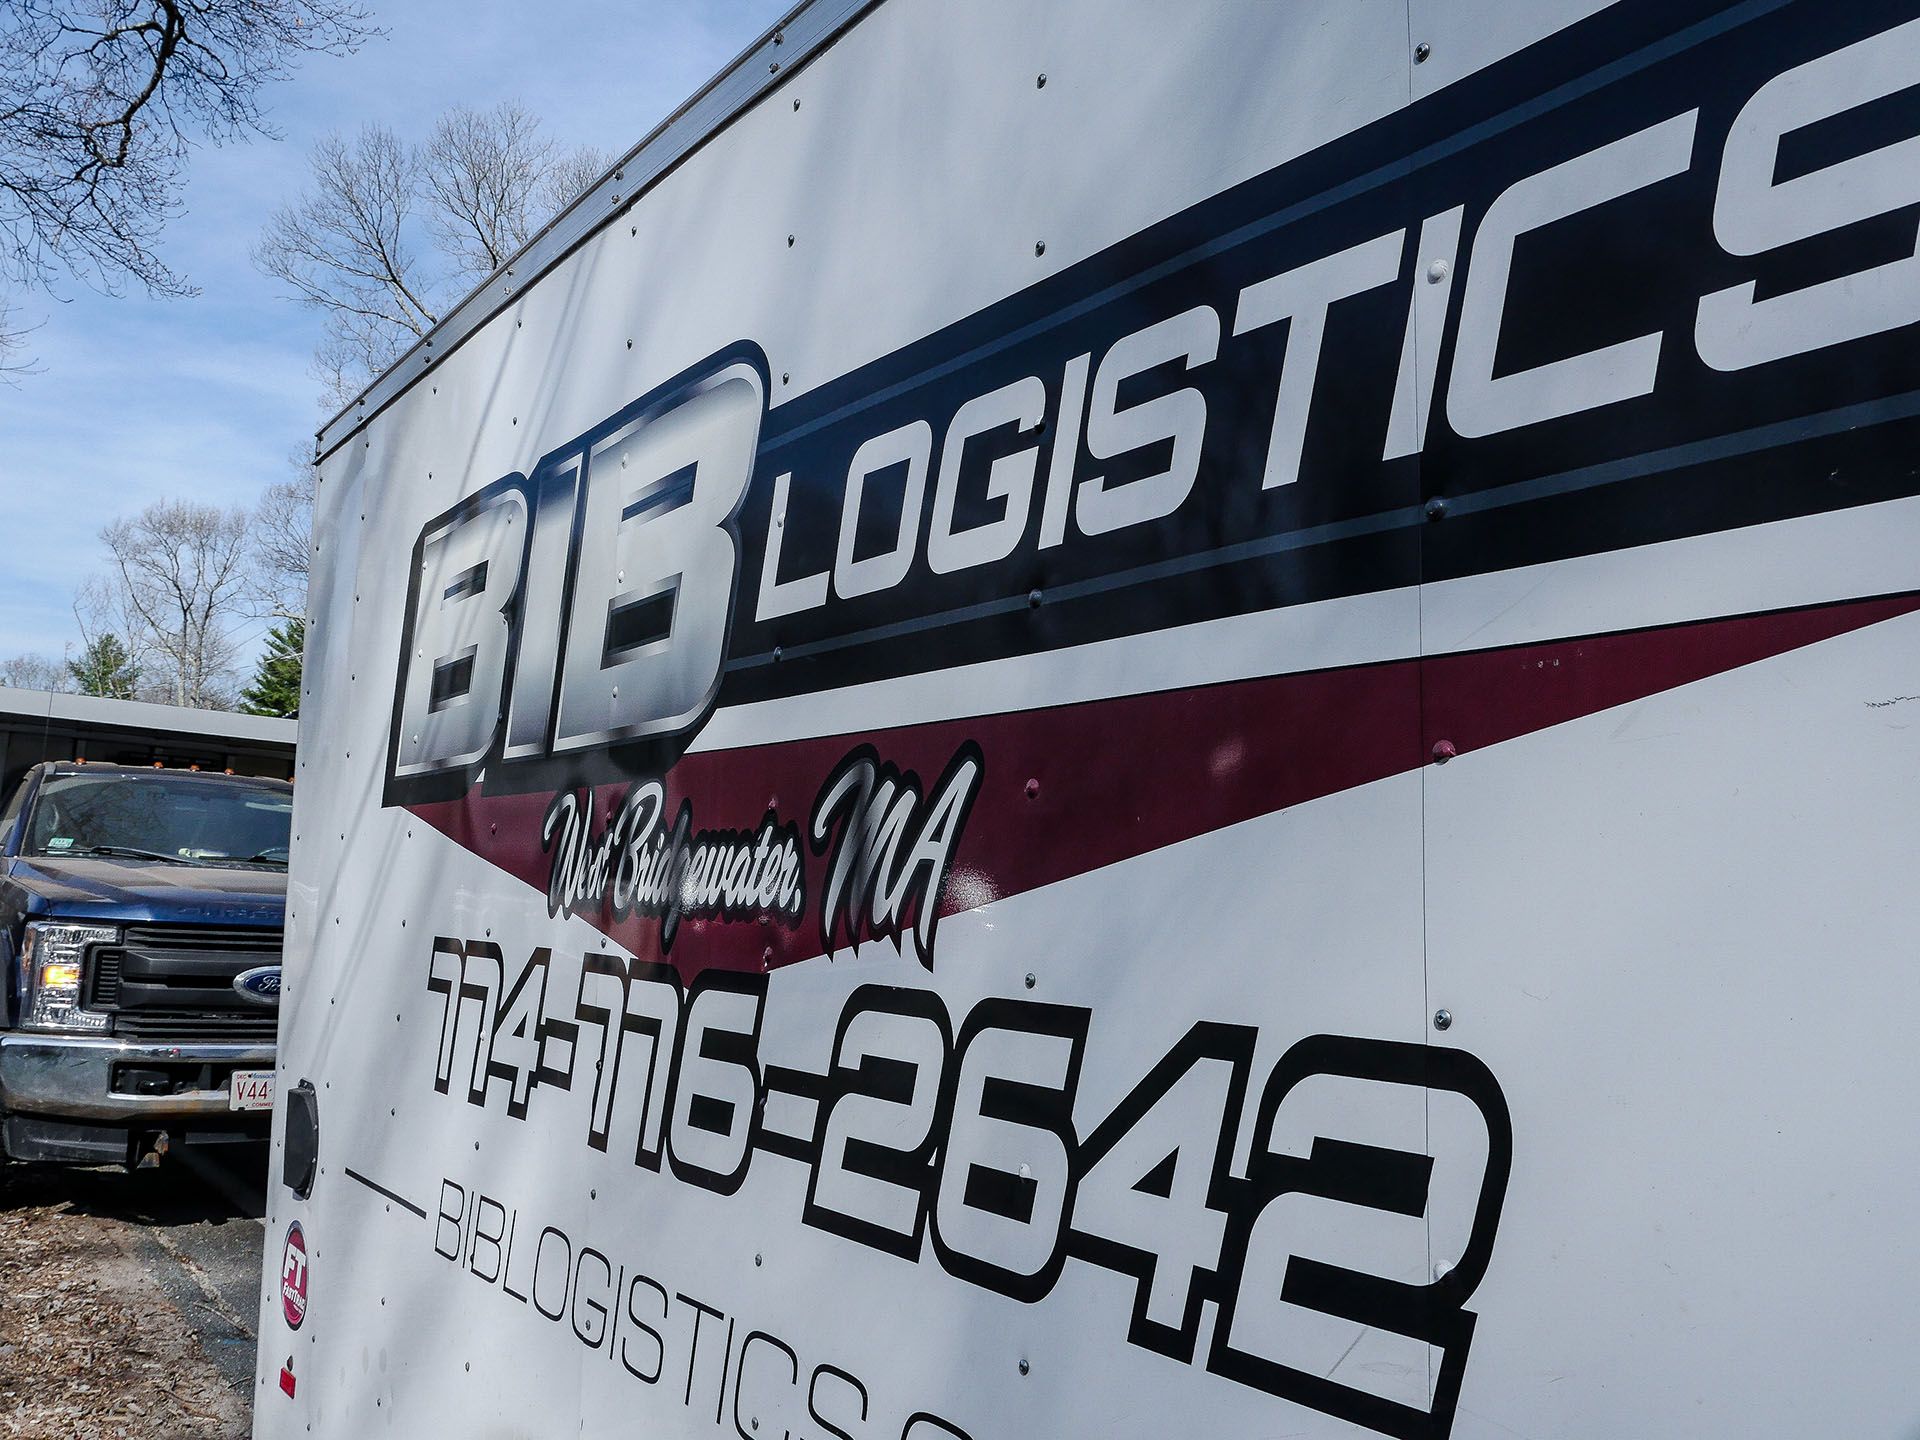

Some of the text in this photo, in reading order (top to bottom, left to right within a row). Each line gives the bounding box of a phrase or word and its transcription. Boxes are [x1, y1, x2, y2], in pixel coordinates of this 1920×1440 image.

[386, 17, 1920, 790] BIB LOGISTICS
[542, 786, 615, 912] West
[812, 750, 981, 960] MA
[283, 1242, 306, 1289] FT
[427, 936, 1513, 1440] 774-776-2642
[434, 1177, 976, 1440] BIBLOGISTICS
